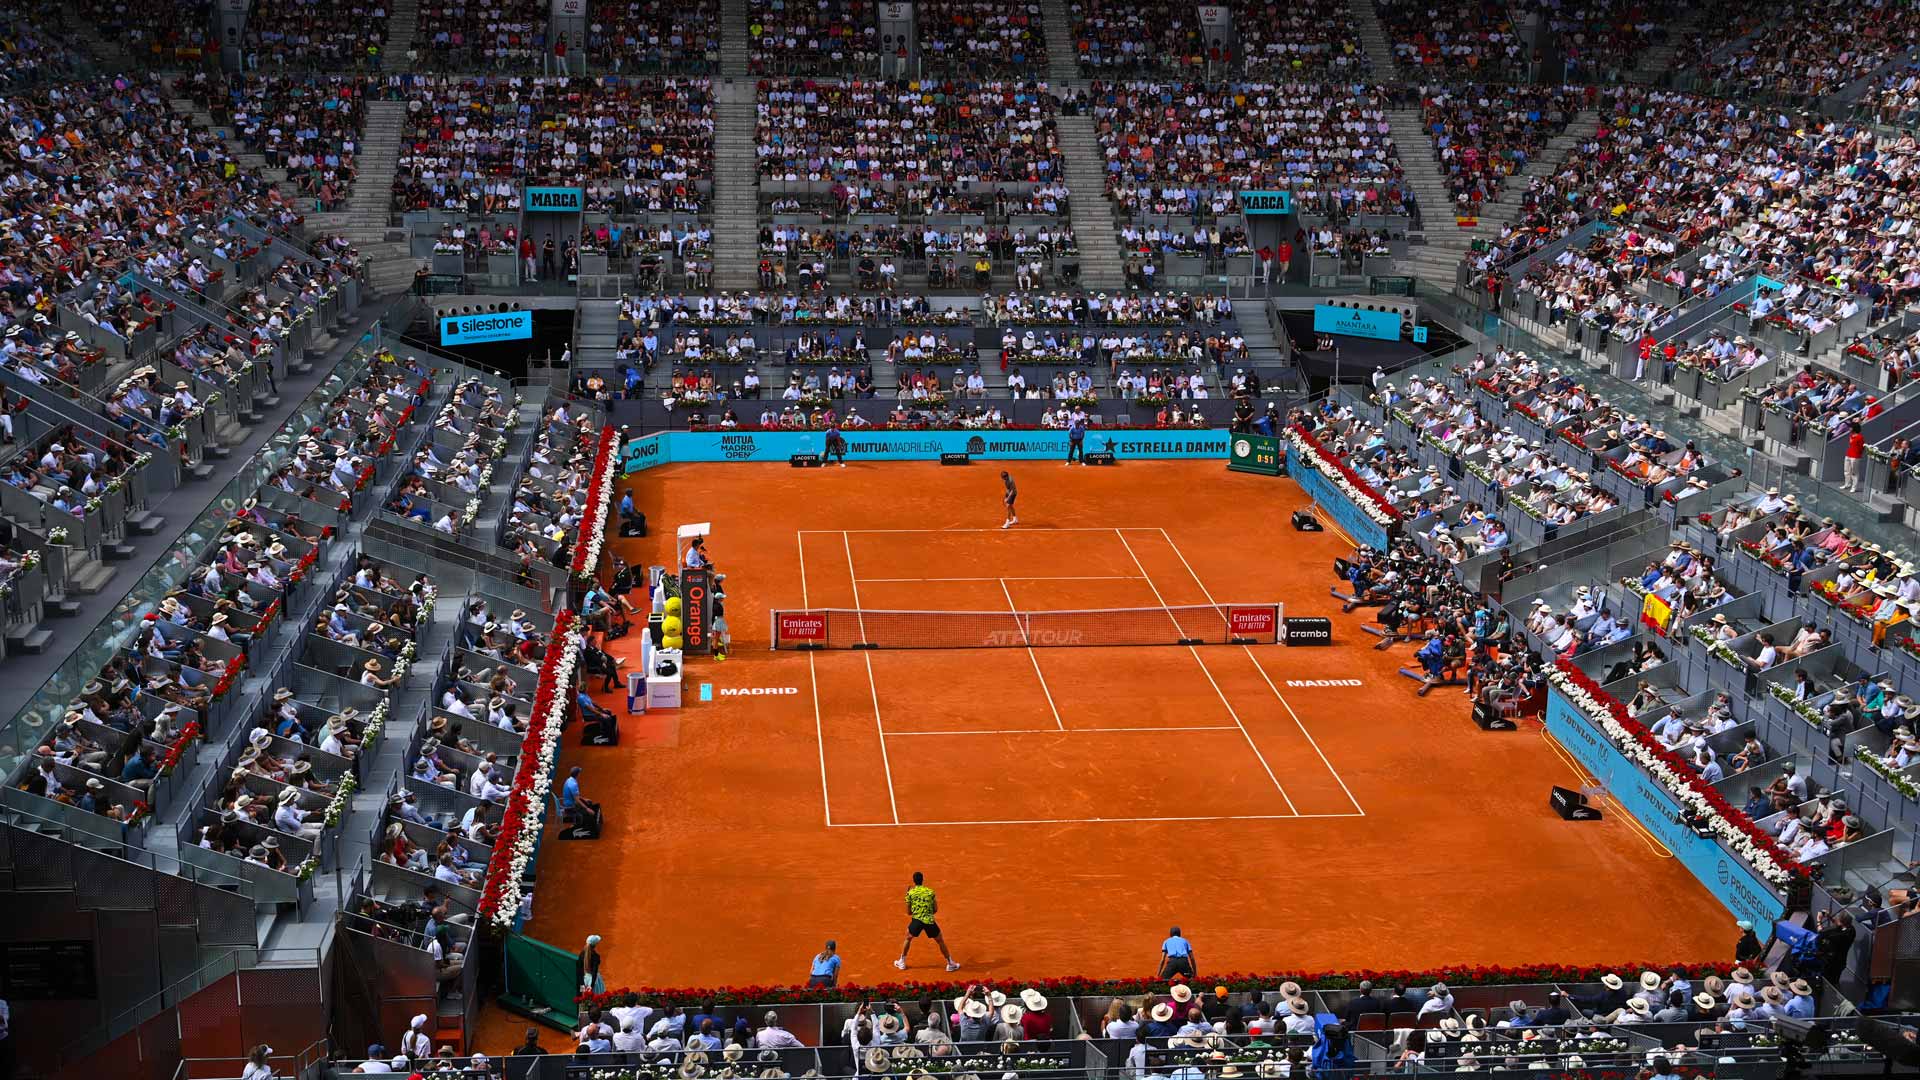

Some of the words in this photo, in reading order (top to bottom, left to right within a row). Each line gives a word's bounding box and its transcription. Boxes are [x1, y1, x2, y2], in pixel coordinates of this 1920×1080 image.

[531, 193, 578, 207] MARCA
[1241, 196, 1284, 209] MARCA
[462, 317, 523, 333] silestone
[1336, 320, 1377, 330] ANANTARA
[722, 435, 754, 444] MUTUA
[720, 444, 756, 452] MADRID
[851, 439, 944, 453] MUTUAMADRILEÑA
[989, 441, 1069, 453] MUTUAMADRILE
[1121, 441, 1183, 453] ESTRELLA
[1186, 441, 1227, 453] DAMM
[1257, 454, 1274, 465] 0:51
[687, 586, 705, 646] Orange
[1233, 613, 1271, 623] Emirates
[783, 619, 823, 628] Emirates
[1030, 629, 1083, 644] TOUR
[1290, 630, 1329, 638] crambo
[1285, 679, 1363, 687] MADRID
[720, 687, 799, 696] MADRID
[1566, 713, 1597, 747] DUNLOP
[1730, 874, 1775, 923] PROSEGUR
[1730, 892, 1759, 927] SECURITY
